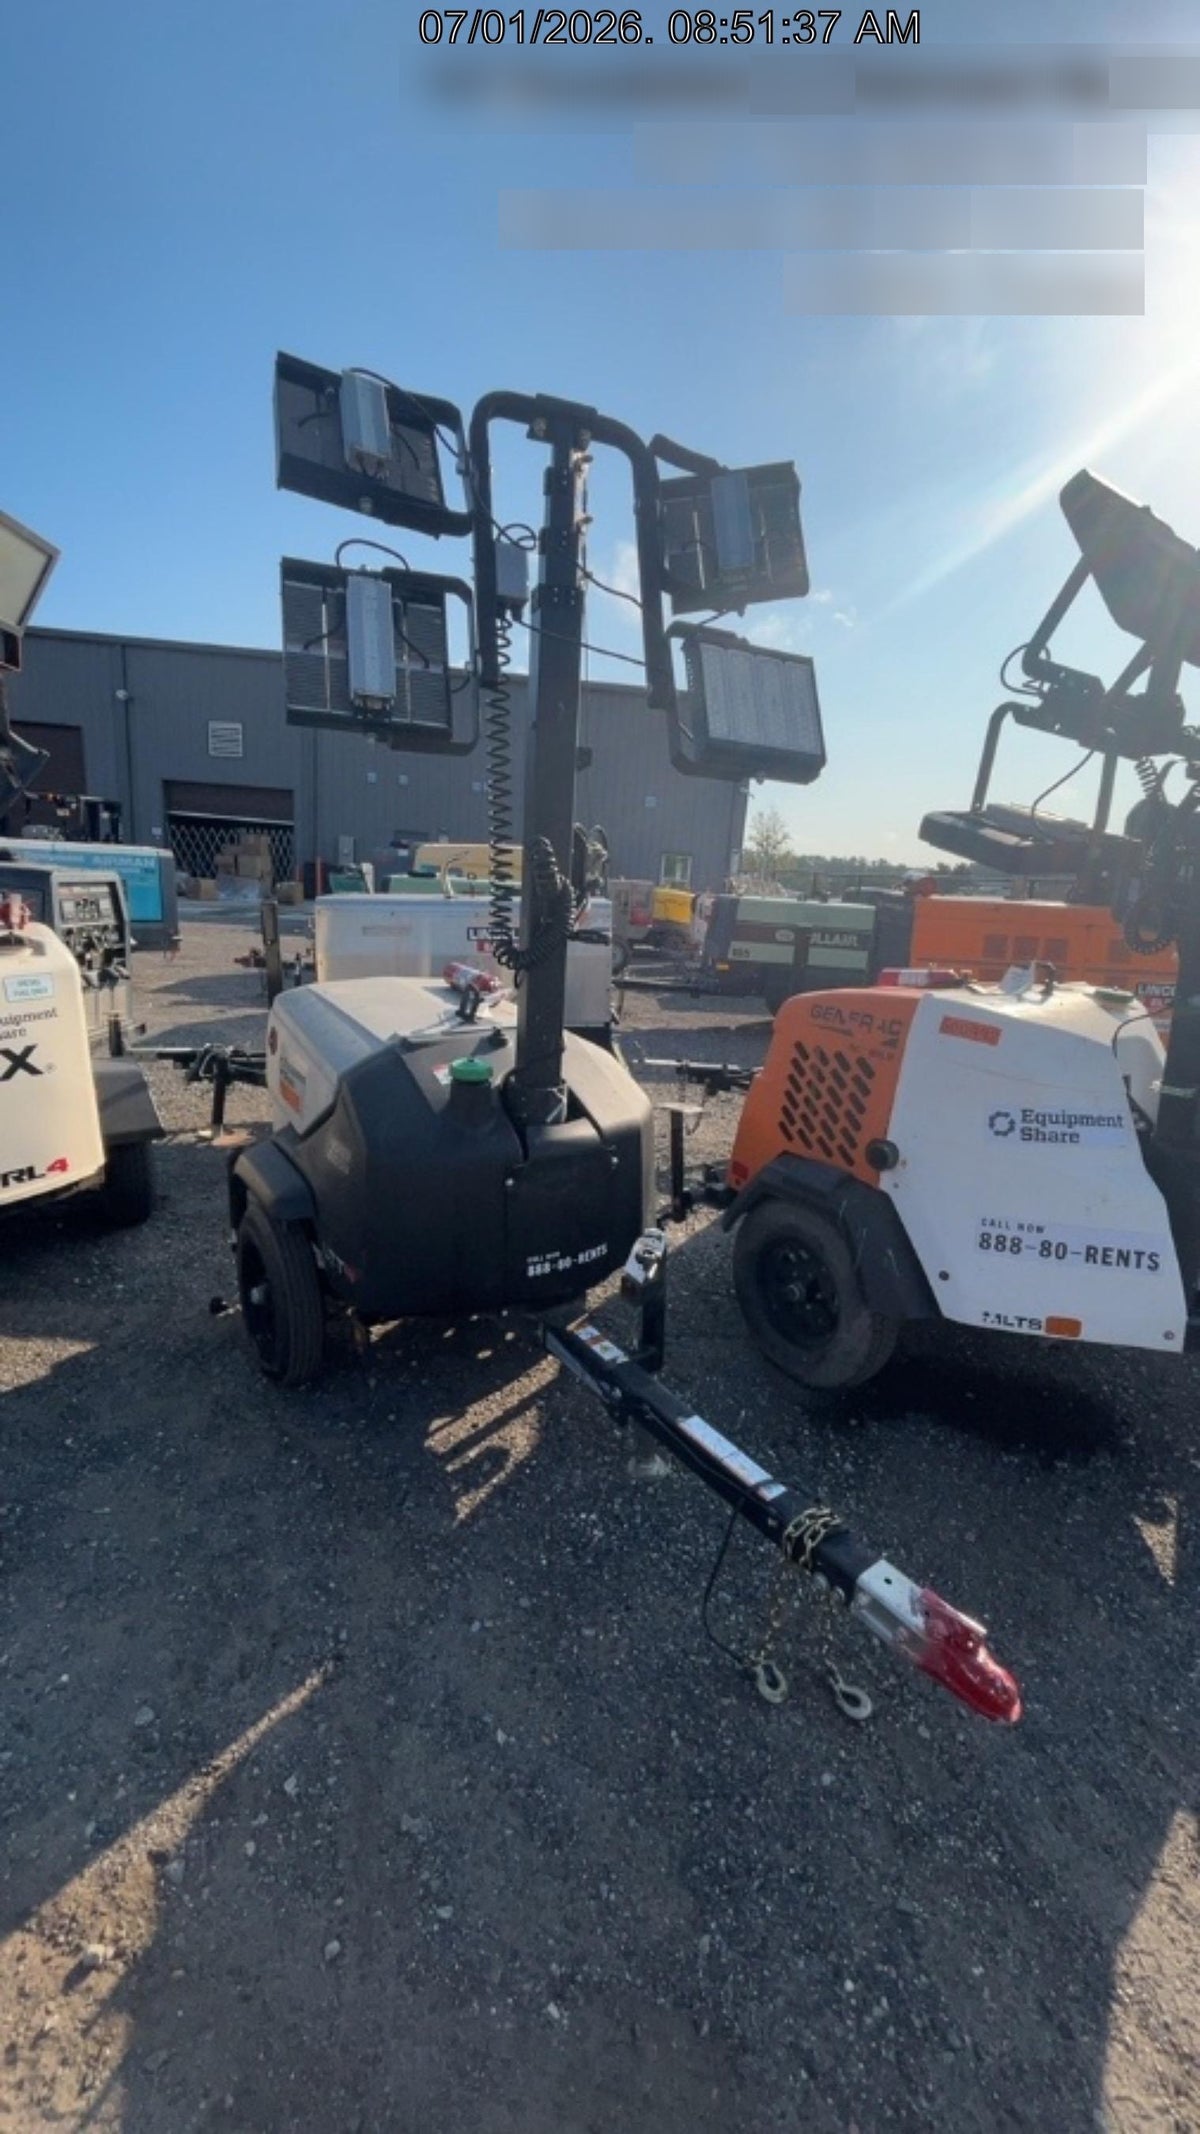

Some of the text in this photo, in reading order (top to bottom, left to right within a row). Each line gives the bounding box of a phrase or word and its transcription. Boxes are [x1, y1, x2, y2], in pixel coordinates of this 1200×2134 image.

[1020, 1109, 1125, 1128] Equipment
[1020, 1126, 1080, 1144] Share
[981, 1217, 1046, 1234] CALL NOW
[978, 1232, 1161, 1272] 888-80-RENTS
